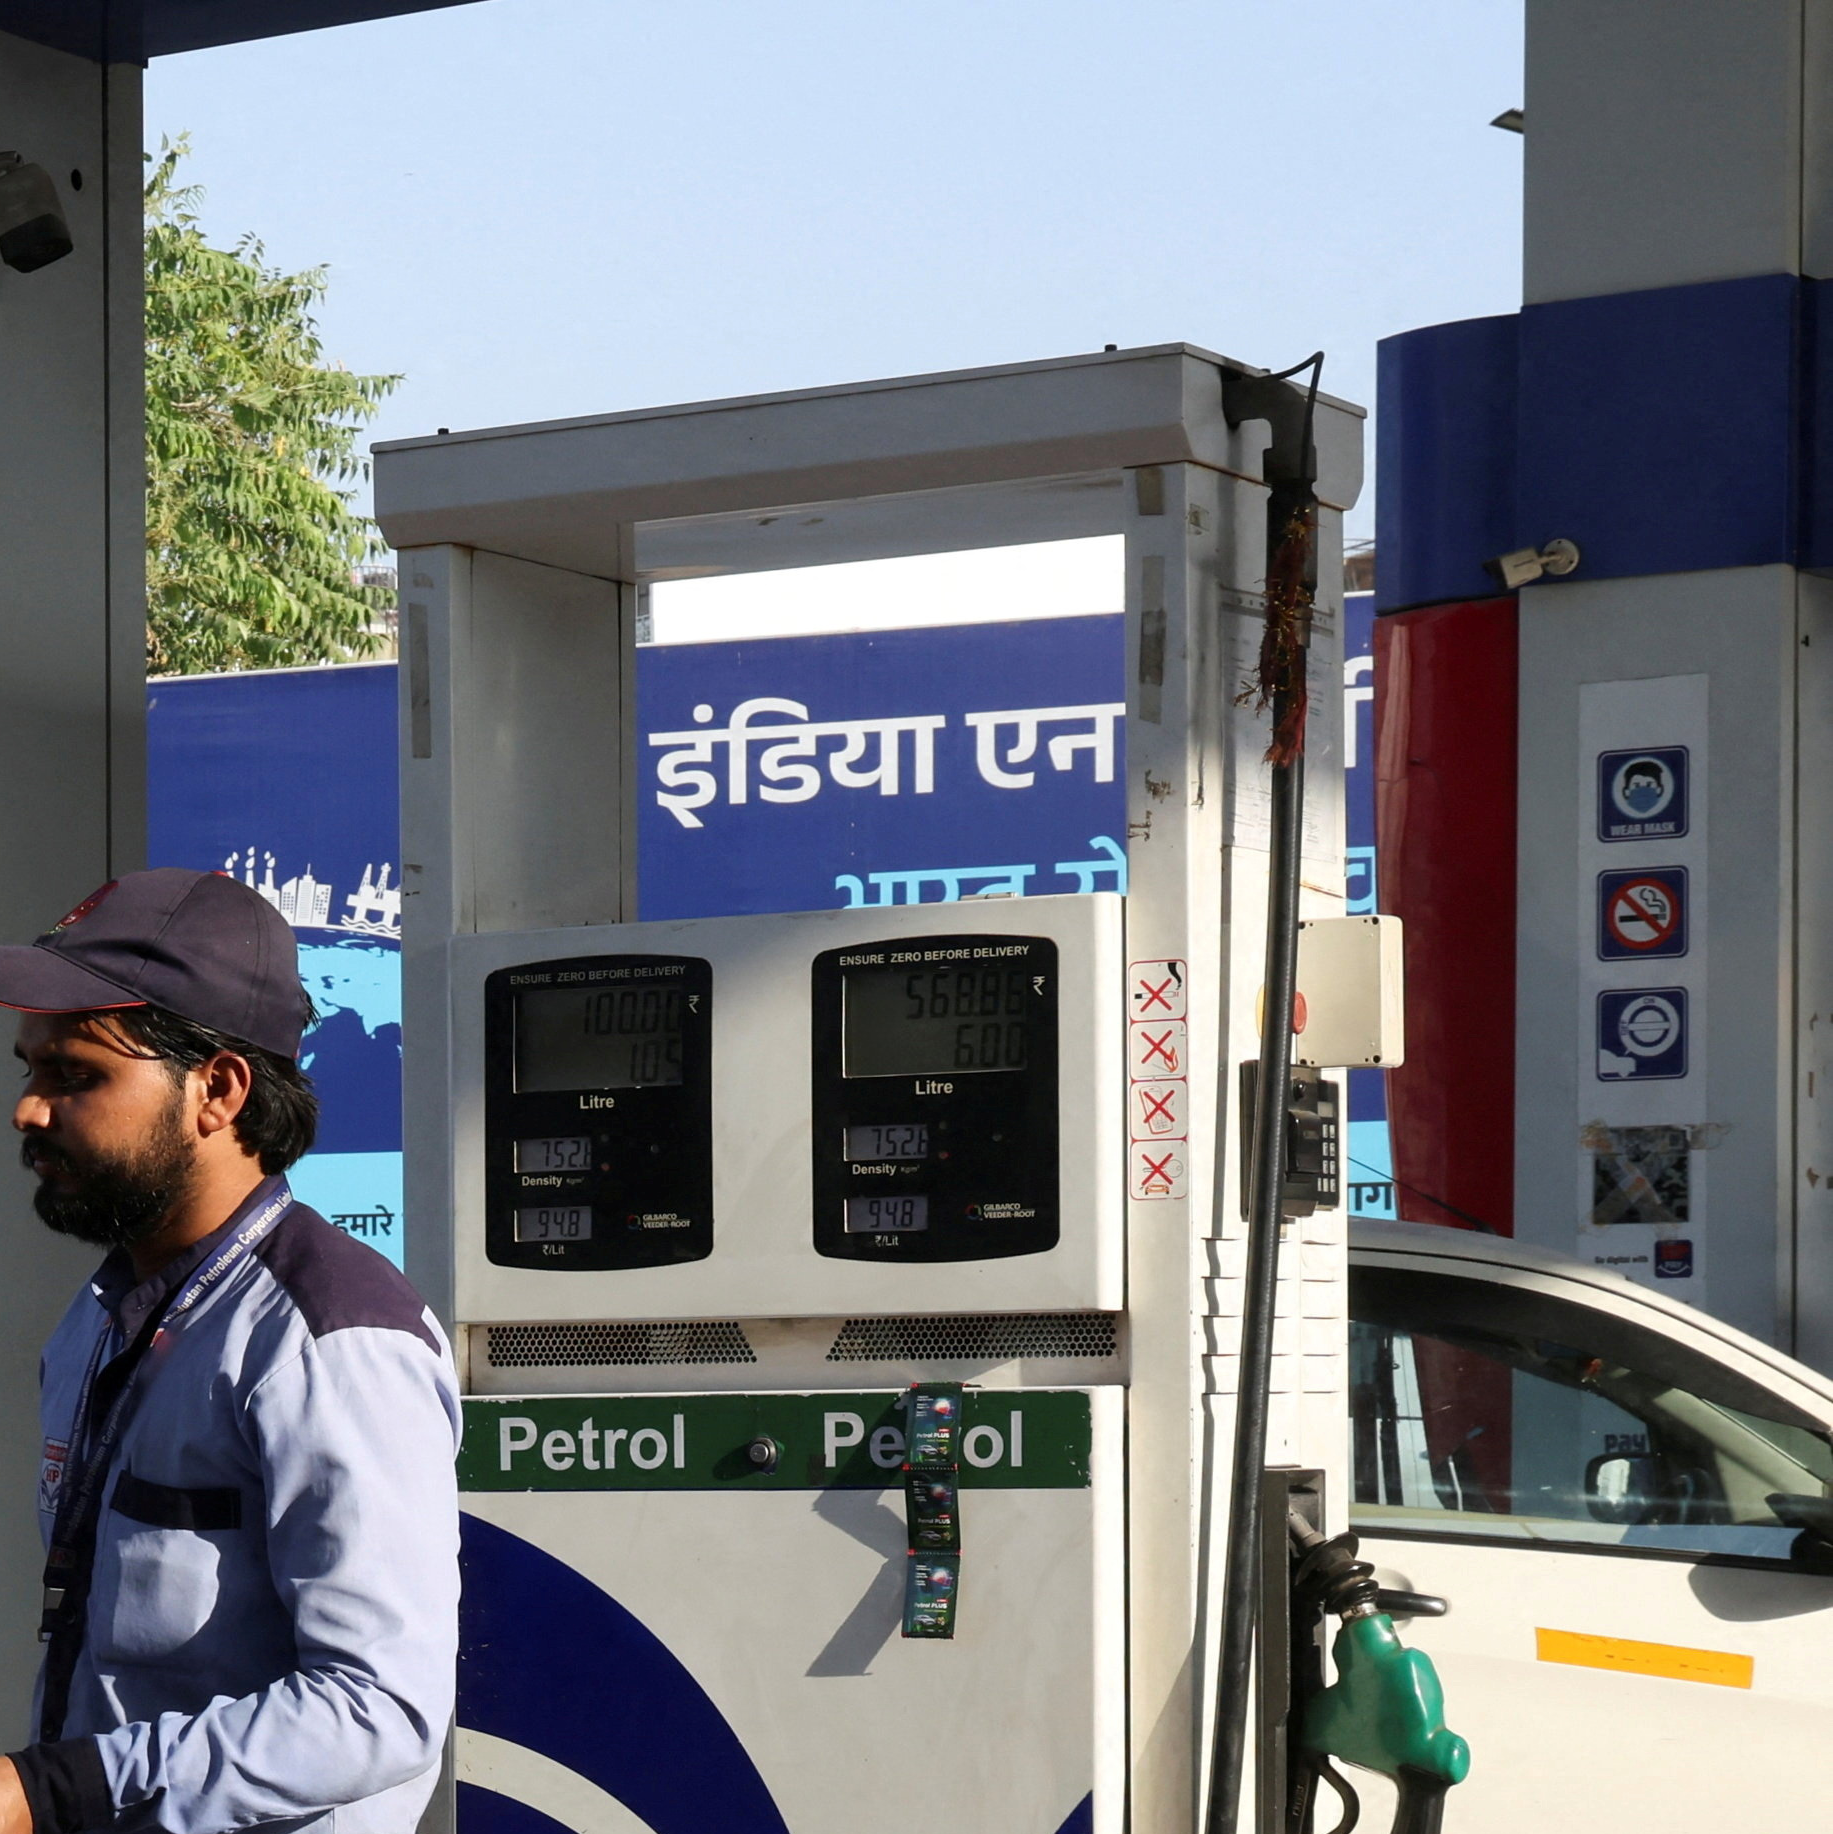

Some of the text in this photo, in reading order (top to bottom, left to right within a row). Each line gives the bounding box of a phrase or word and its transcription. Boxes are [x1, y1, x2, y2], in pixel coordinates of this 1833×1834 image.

[648, 697, 946, 829] इंडिया
[1610, 820, 1676, 837] WEAR MASK
[839, 946, 1030, 966] ENSURE ZERO BEFORE DELIVERY
[510, 965, 686, 985] ENSURE ZERO BEFORE DELIVERY
[915, 1080, 954, 1095] Litre
[579, 1096, 615, 1110] Litre
[852, 1163, 897, 1177] Density
[521, 1175, 563, 1188] Density
[199, 1242, 244, 1285] Petroleum
[238, 1203, 283, 1245] Corporation
[499, 1413, 685, 1472] Petrol
[823, 1409, 1023, 1469] Peol
[933, 1431, 950, 1439] PLUS
